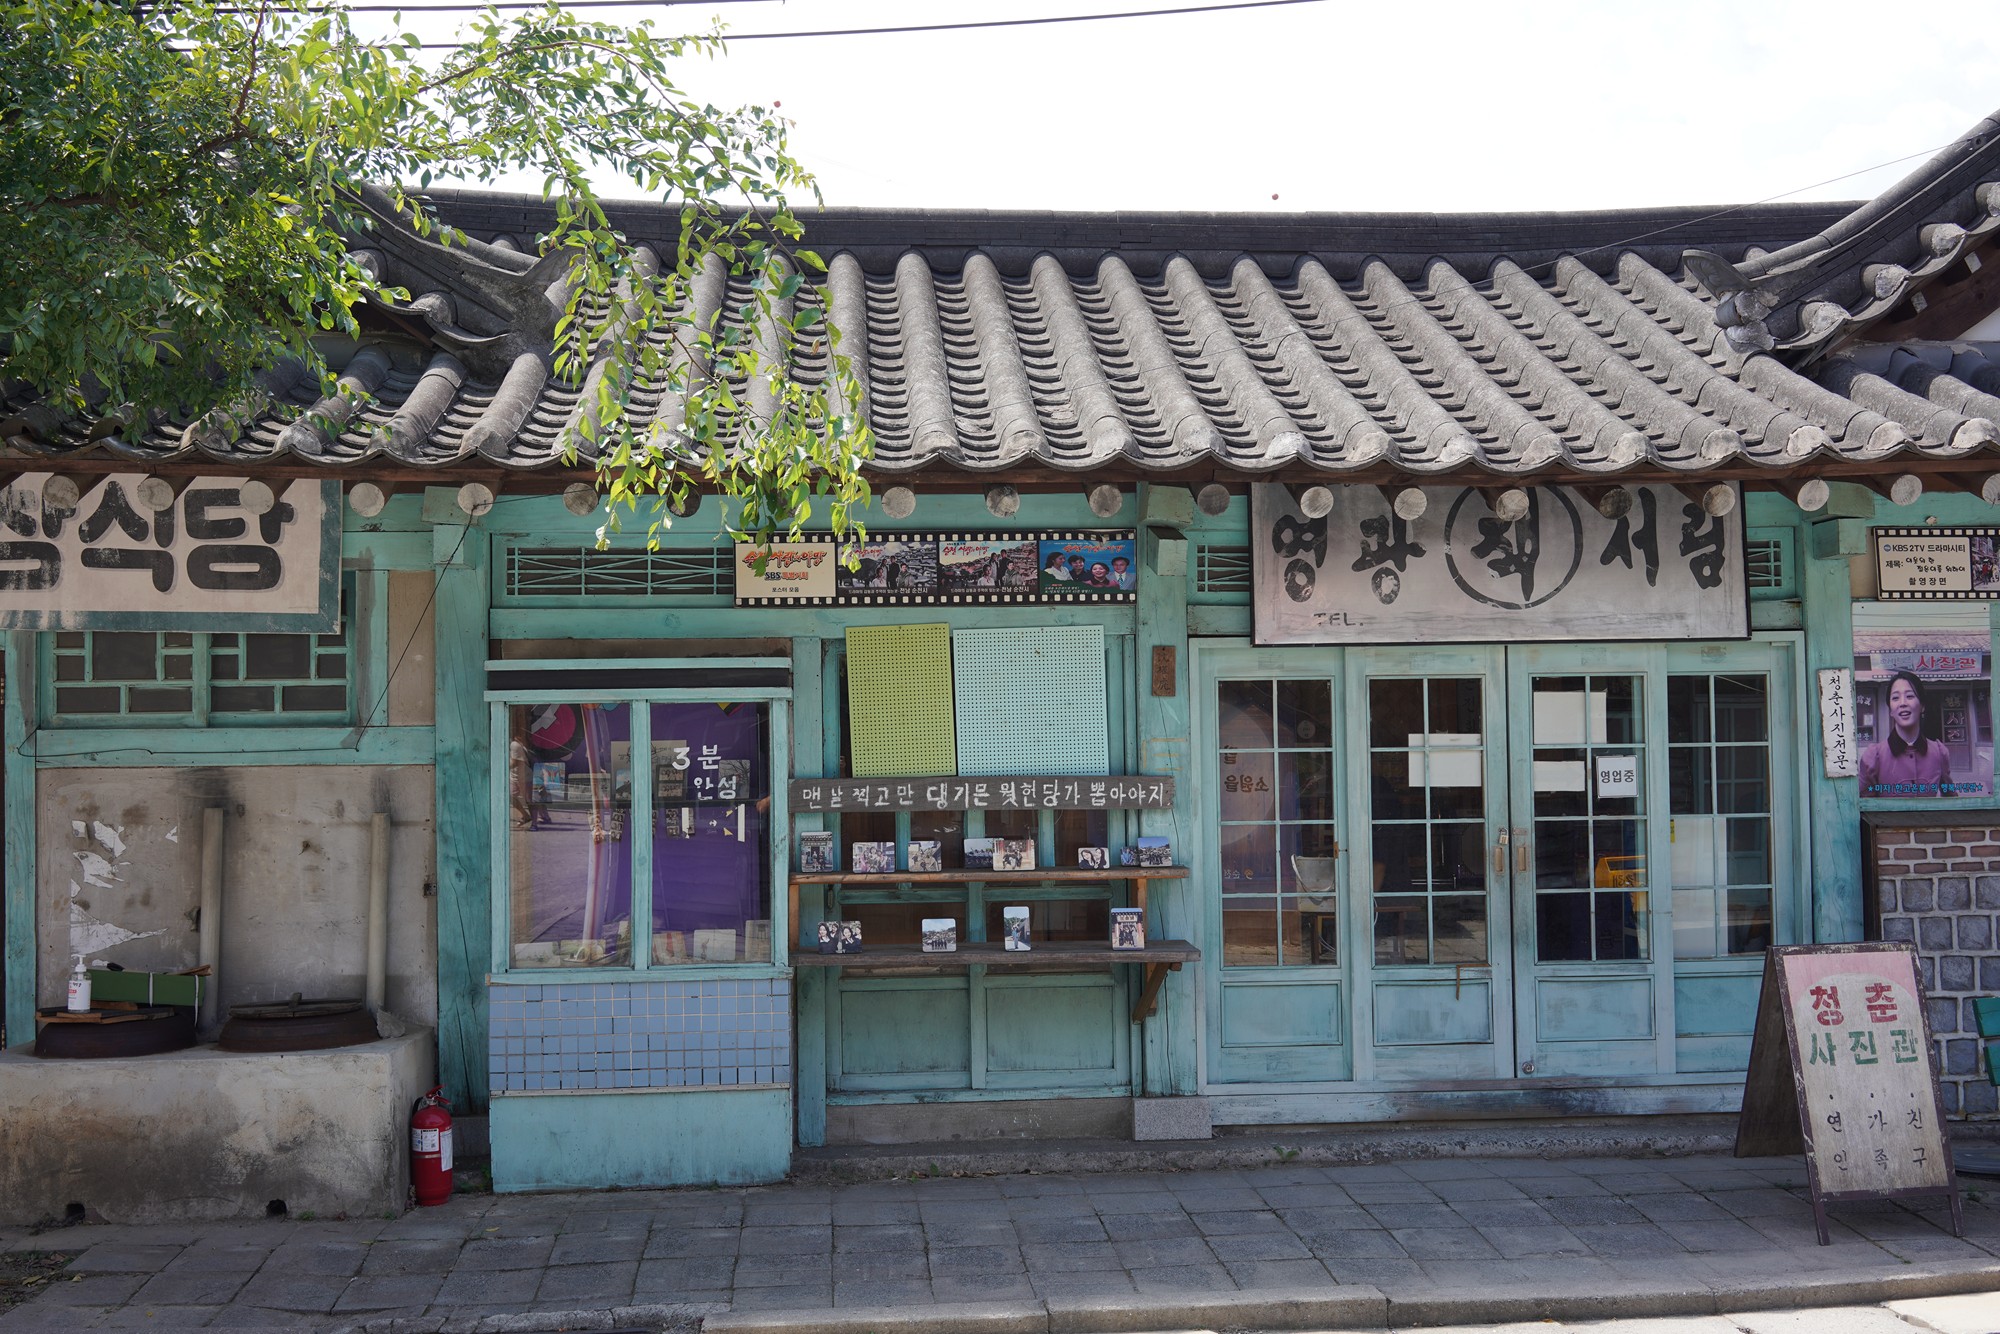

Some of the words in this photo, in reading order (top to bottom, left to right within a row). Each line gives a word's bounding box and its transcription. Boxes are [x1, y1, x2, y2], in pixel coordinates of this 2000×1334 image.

[1892, 544, 1909, 552] KBS
[1909, 544, 1925, 552] 2TV
[1927, 543, 1966, 553] 드라마시티
[1885, 560, 1904, 569] 제목:
[764, 571, 781, 580] SBS
[1916, 654, 1977, 670] 사진관
[1599, 770, 1635, 784] 영업중
[1809, 983, 1898, 1026] 청춘
[1809, 1029, 1918, 1067] 사진관
